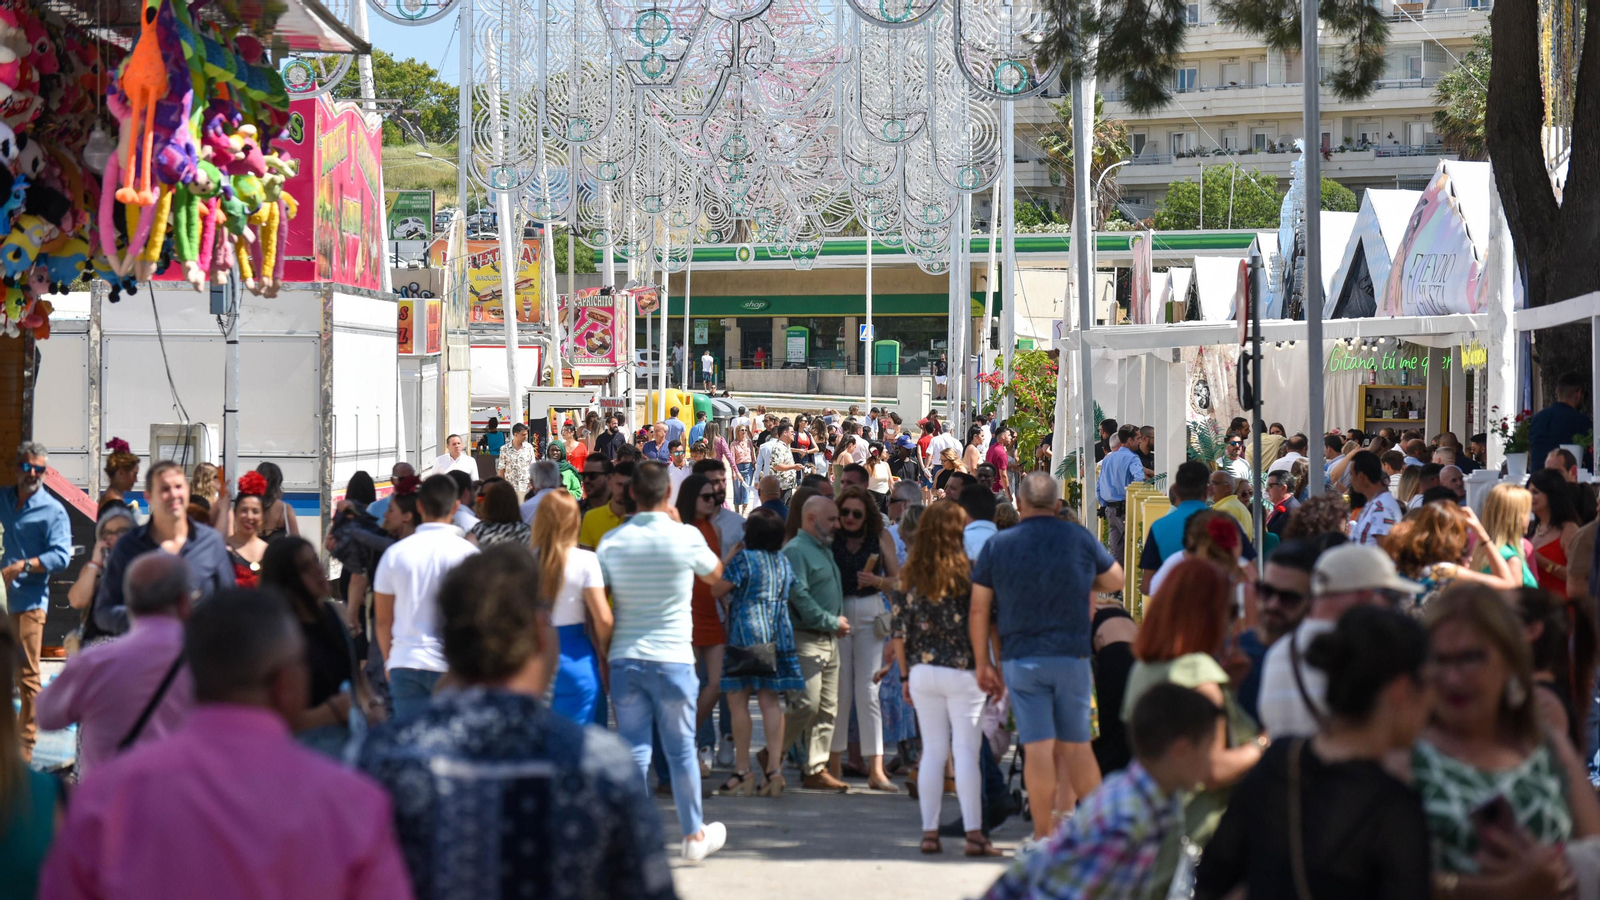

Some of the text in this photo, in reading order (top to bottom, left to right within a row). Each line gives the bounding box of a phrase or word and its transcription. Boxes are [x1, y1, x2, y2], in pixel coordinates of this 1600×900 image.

[742, 300, 765, 310] shop
[1330, 347, 1378, 372] Gitana,
[1382, 351, 1396, 371] tú
[1399, 356, 1418, 370] me
[600, 398, 624, 408] TAQUILLA
